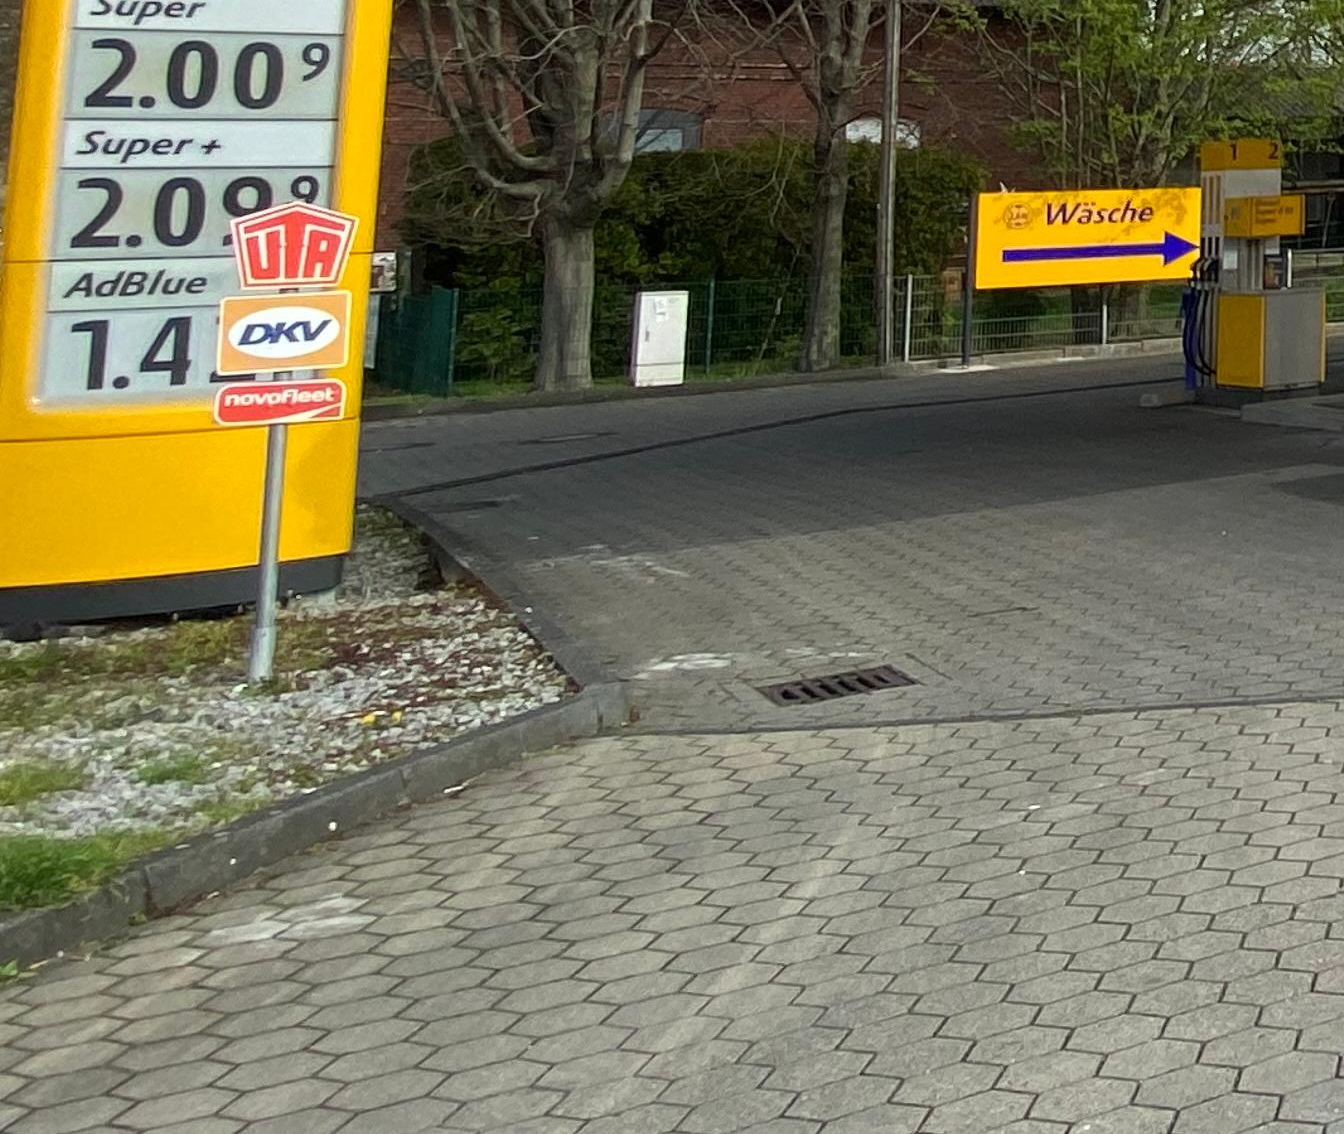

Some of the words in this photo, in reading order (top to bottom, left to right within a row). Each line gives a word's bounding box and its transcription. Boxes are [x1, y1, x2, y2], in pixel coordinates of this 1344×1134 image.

[76, 130, 195, 164] Super
[201, 139, 222, 156] +
[1229, 143, 1238, 161] 1
[1267, 142, 1279, 159] 2
[1046, 199, 1154, 226] Wäsche
[244, 211, 346, 280] UTA
[64, 271, 208, 299] AdBlue
[238, 319, 332, 346] DKV
[223, 387, 336, 407] novofleet
